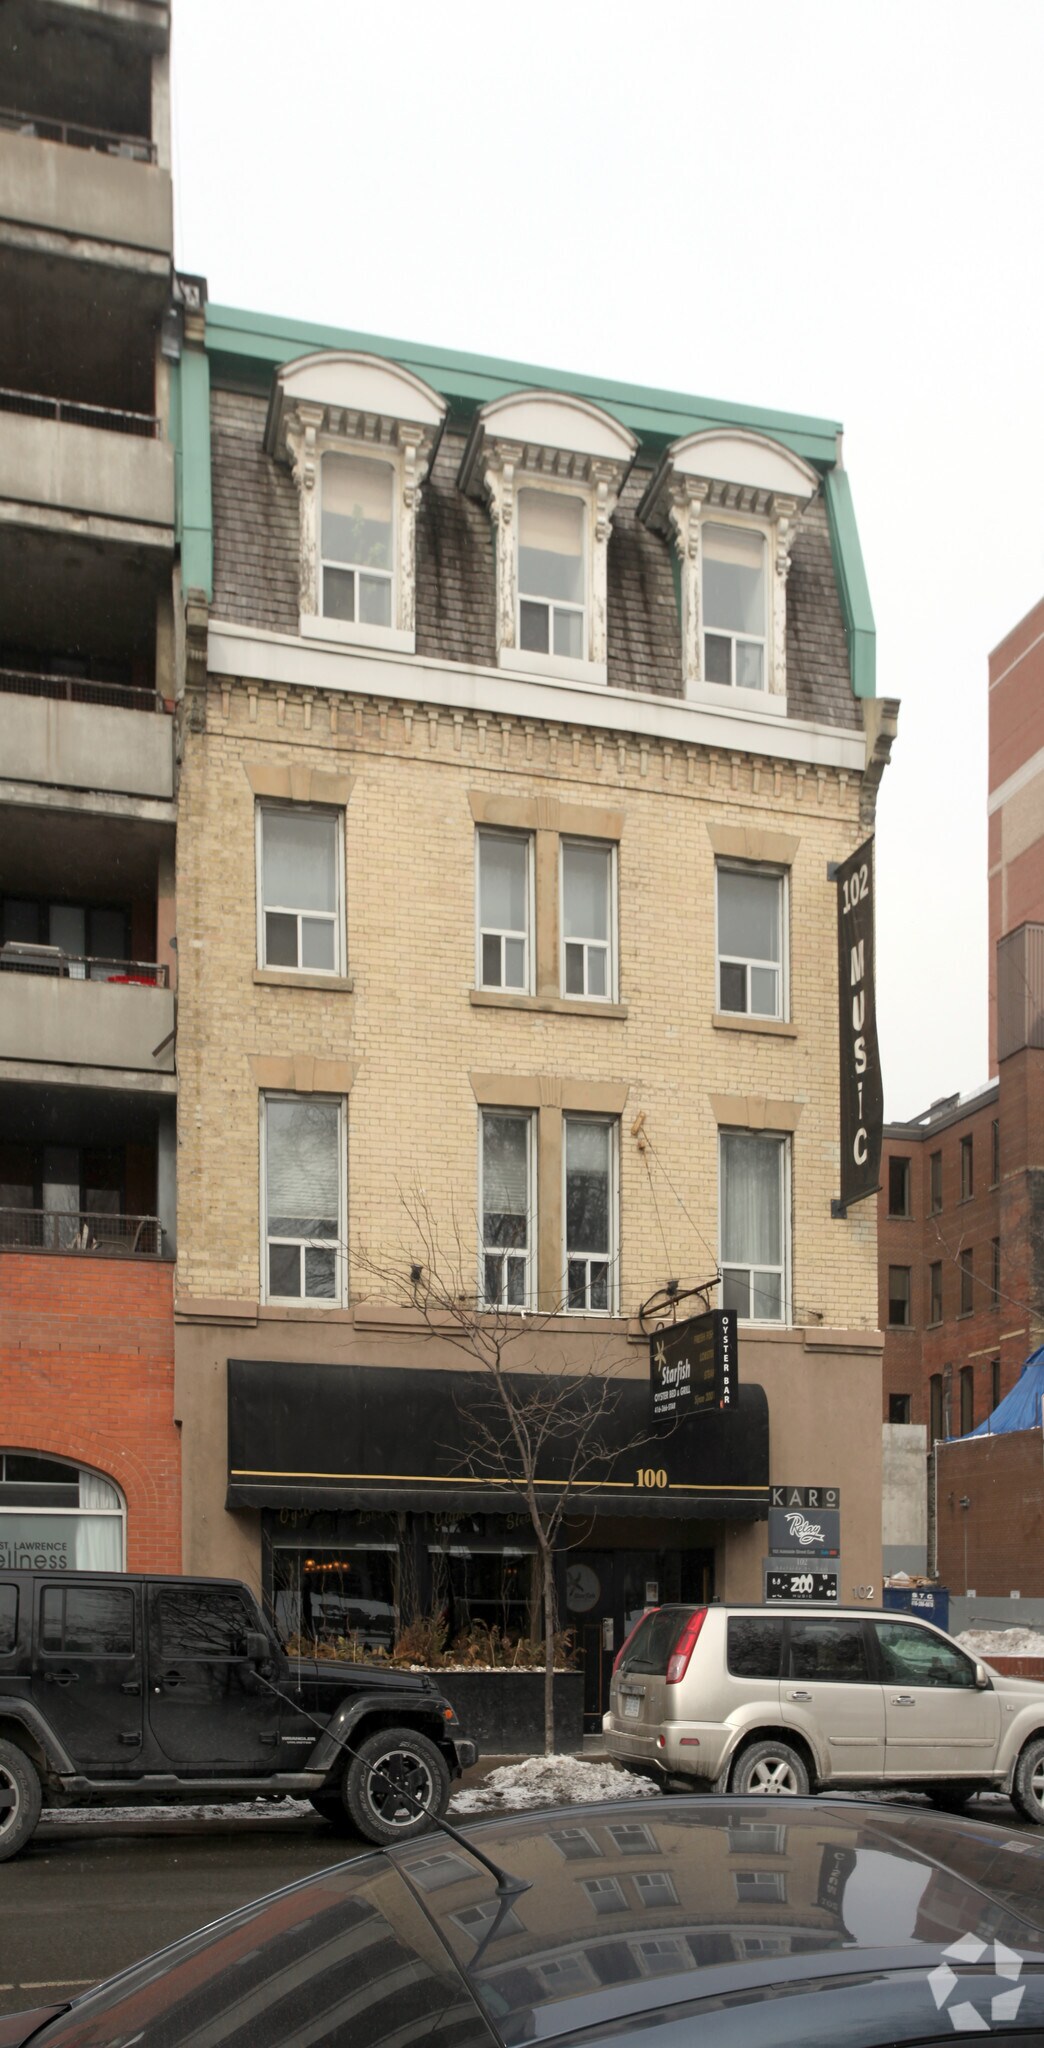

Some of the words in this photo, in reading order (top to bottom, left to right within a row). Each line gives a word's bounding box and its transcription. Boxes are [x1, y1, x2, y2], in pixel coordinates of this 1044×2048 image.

[842, 863, 869, 914] 102
[721, 1316, 730, 1372] OYSTER
[661, 1358, 691, 1387] Starfish
[654, 1391, 669, 1402] OYSTER
[680, 1385, 691, 1396] GRILL
[723, 1377, 731, 1404] BAR
[636, 1468, 668, 1489] 100
[784, 1512, 826, 1545] Relay
[14, 1541, 67, 1551] LAWRENCE
[852, 1585, 874, 1600] 102
